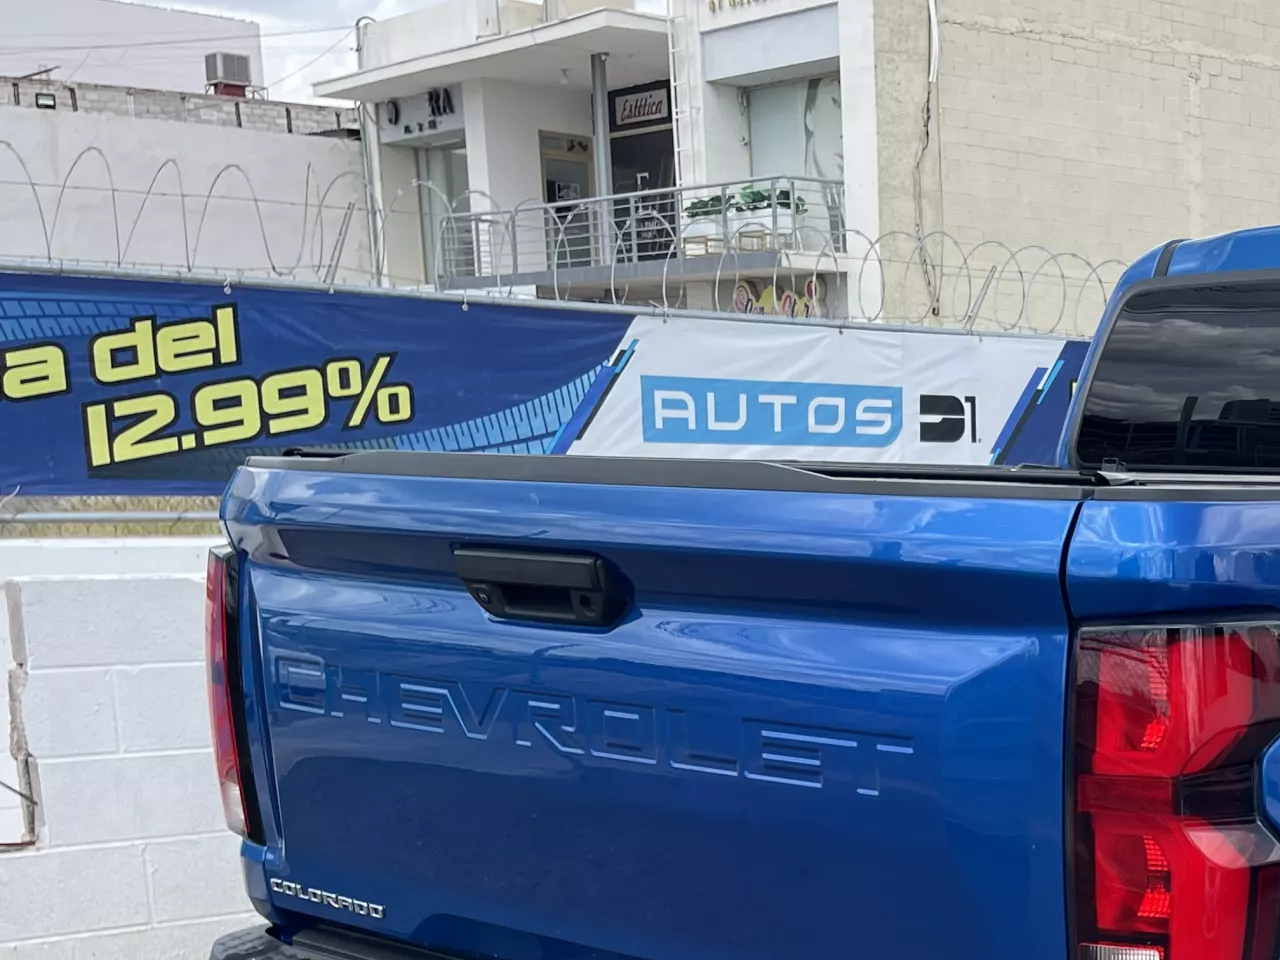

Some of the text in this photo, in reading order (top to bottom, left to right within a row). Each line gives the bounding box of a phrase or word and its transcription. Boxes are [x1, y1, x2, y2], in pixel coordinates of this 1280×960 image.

[92, 305, 239, 384] del
[86, 355, 413, 468] 12.99%
[653, 389, 893, 435] AUTOS
[272, 655, 914, 796] CHEVROLET
[270, 877, 384, 919] COLORADO
